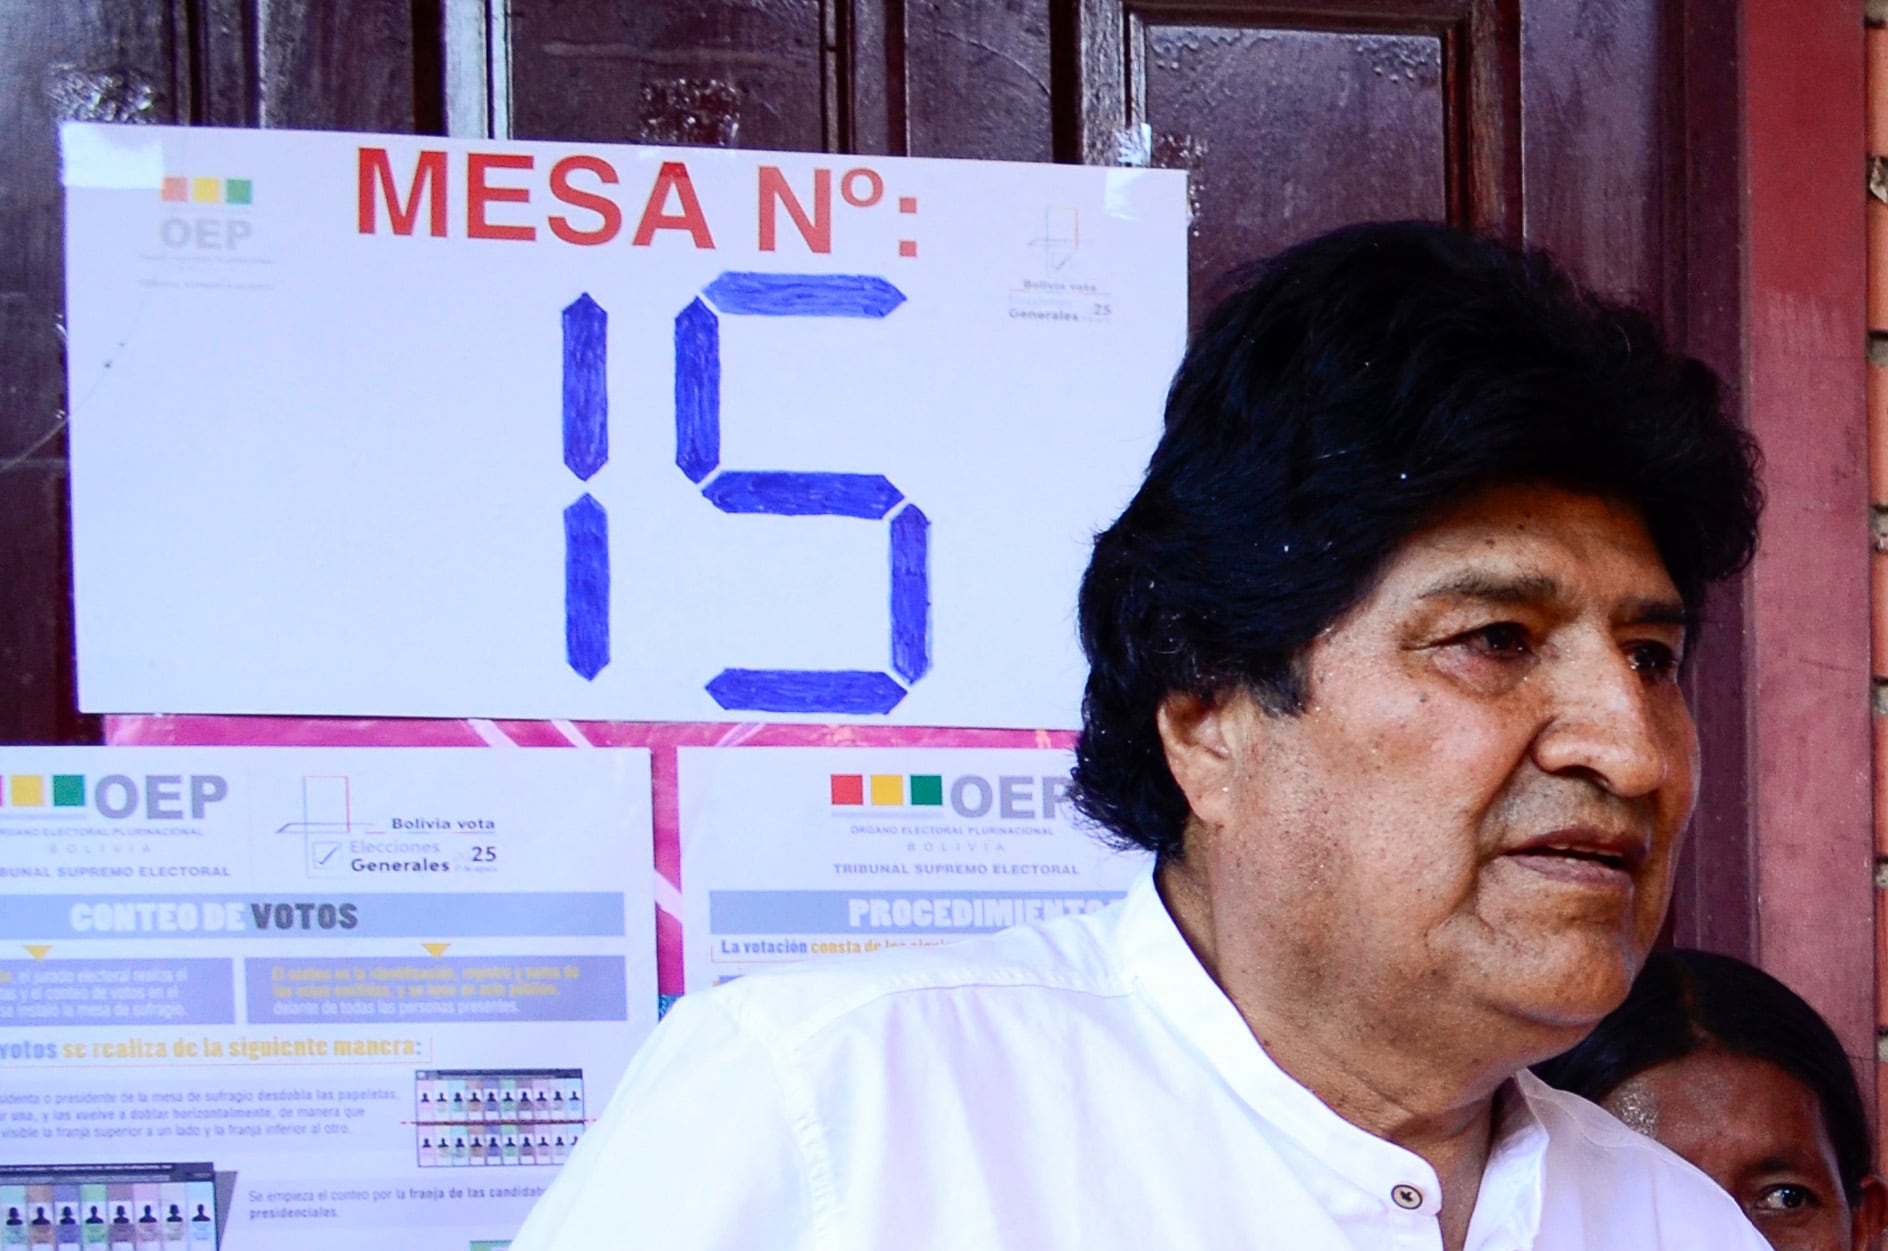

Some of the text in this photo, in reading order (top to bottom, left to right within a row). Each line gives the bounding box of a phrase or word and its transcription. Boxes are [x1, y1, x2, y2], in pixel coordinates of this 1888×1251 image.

[357, 147, 714, 249] MESA
[160, 217, 252, 250] OEP
[1008, 308, 1079, 322] Generales
[561, 270, 932, 715] 15
[95, 774, 229, 820] OEP
[392, 817, 495, 830] Bolivia vota
[901, 826, 963, 836] ELECTORAL
[968, 826, 1053, 836] PLURINACIONAL
[350, 839, 439, 854] Elecciones
[471, 845, 497, 862] 25
[908, 842, 1005, 852] BOLIVIA
[0, 866, 231, 878] BUNAL SUPREMO ELECTORAL
[351, 857, 449, 873] Generales
[834, 863, 1079, 876] TRIBUNAL SUPREMO ELECTORAL
[70, 902, 360, 932] CONTEO DE VOTOS
[721, 939, 739, 955] La
[744, 938, 808, 955] votación
[63, 1043, 87, 1058] se
[92, 1038, 167, 1058] realiza
[173, 1037, 198, 1058] de
[204, 1037, 223, 1058] la
[229, 1036, 327, 1061] siguiente
